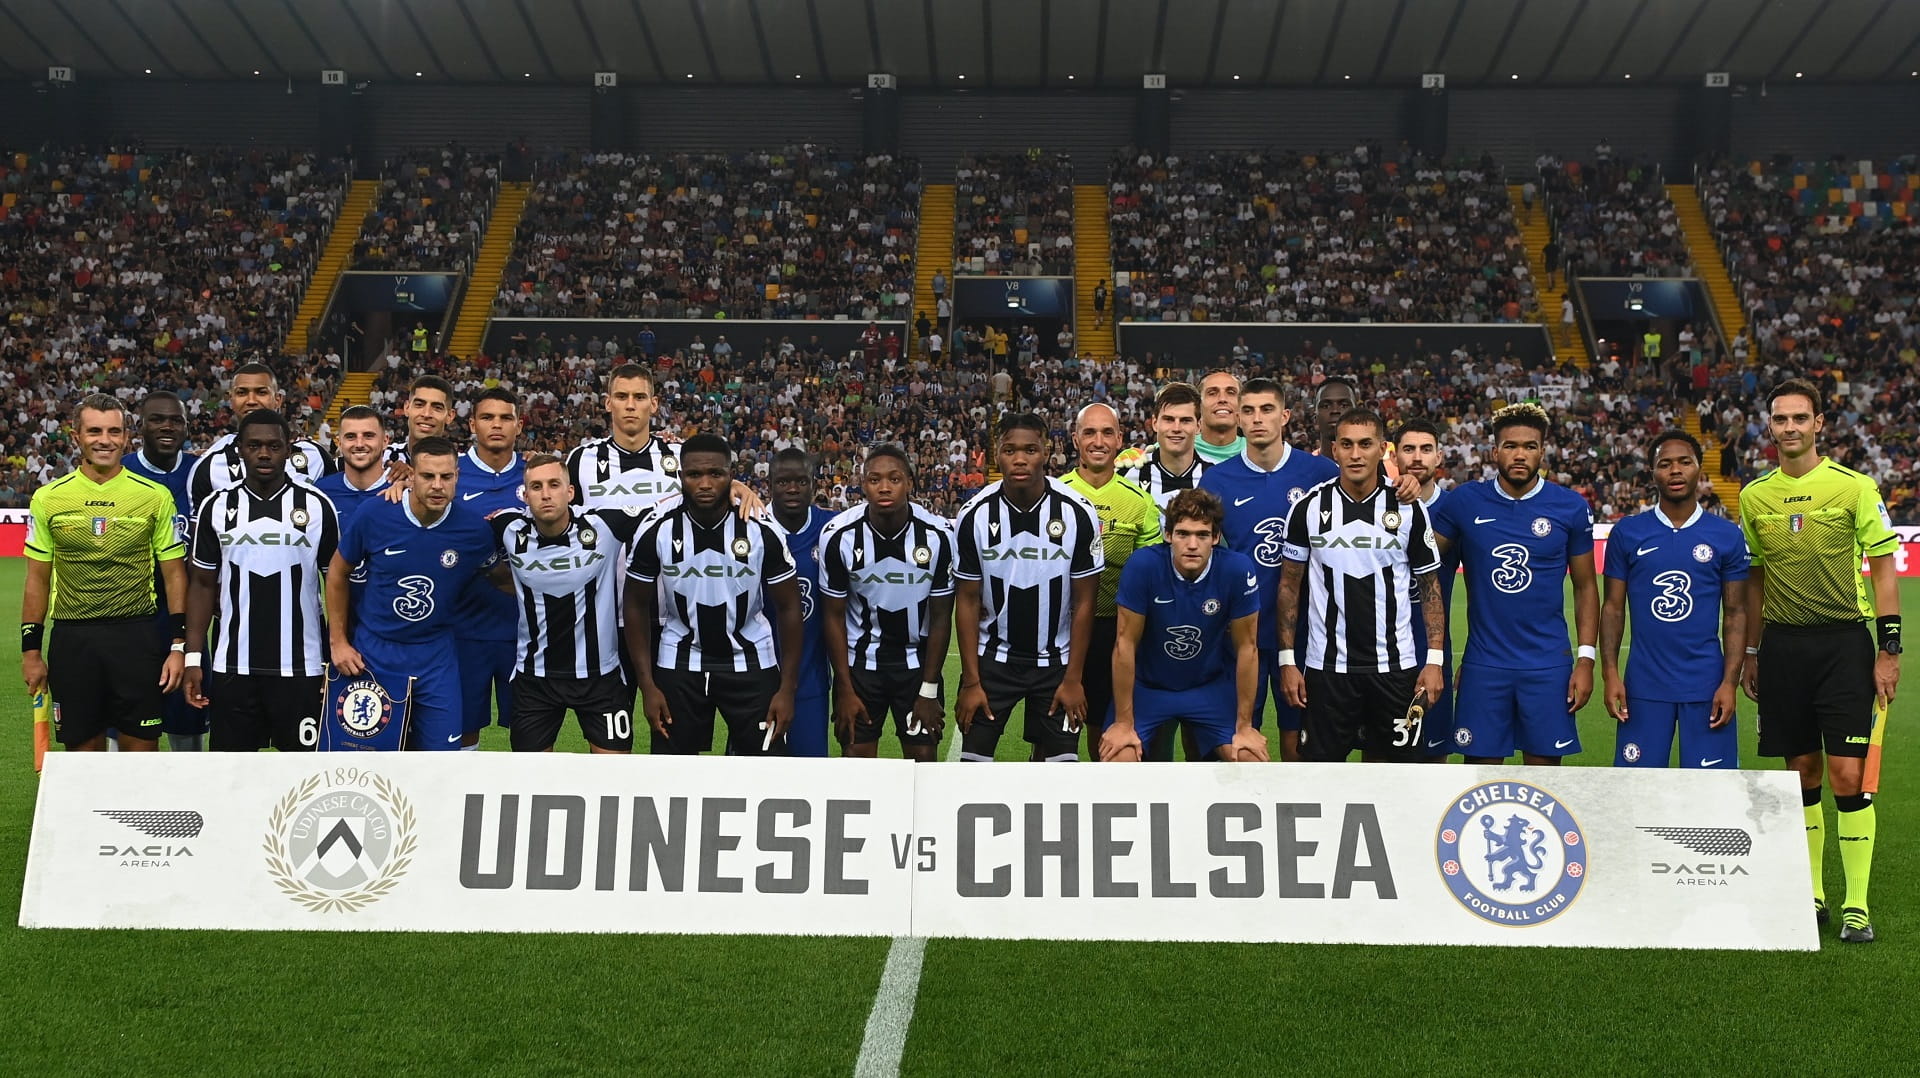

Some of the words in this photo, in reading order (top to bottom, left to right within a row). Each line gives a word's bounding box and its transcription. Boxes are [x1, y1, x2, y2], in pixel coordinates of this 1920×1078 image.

[54, 70, 66, 79] 17
[327, 73, 339, 82] 18
[1711, 75, 1724, 85] 23
[395, 276, 408, 285] V7
[1006, 281, 1019, 290] V8
[1629, 282, 1643, 292] V9
[588, 481, 682, 497] DACIA
[1784, 495, 1812, 503] LEGEA
[218, 533, 312, 547] DACIA
[1253, 517, 1286, 567] 3
[1310, 536, 1402, 550] DACIA
[509, 551, 605, 571] DACIA
[981, 547, 1071, 561] DACIA
[662, 565, 756, 578] DACIA
[1491, 543, 1532, 594] 3
[848, 572, 934, 584] DACIA
[393, 575, 434, 622] 3
[1651, 570, 1693, 622] 3
[1164, 624, 1202, 660] 3
[299, 716, 317, 746] 6
[341, 722, 365, 737] FOOTBALL
[602, 709, 631, 739] 10
[366, 727, 379, 736] CLUB
[1392, 718, 1422, 747] 37
[323, 766, 370, 789] 1896
[1458, 784, 1559, 818] CHELSEA
[292, 796, 348, 840] UDINESE
[350, 795, 387, 840] CALCIO
[99, 845, 194, 857] DACIA
[459, 794, 871, 895] UDINESE
[956, 803, 1398, 900] CHELSEA
[120, 860, 171, 868] ARENA
[1651, 862, 1750, 876] DACIA
[1676, 878, 1728, 886] ARENA
[1464, 892, 1530, 921] FOOTBALL
[1535, 892, 1566, 916] CLUB
